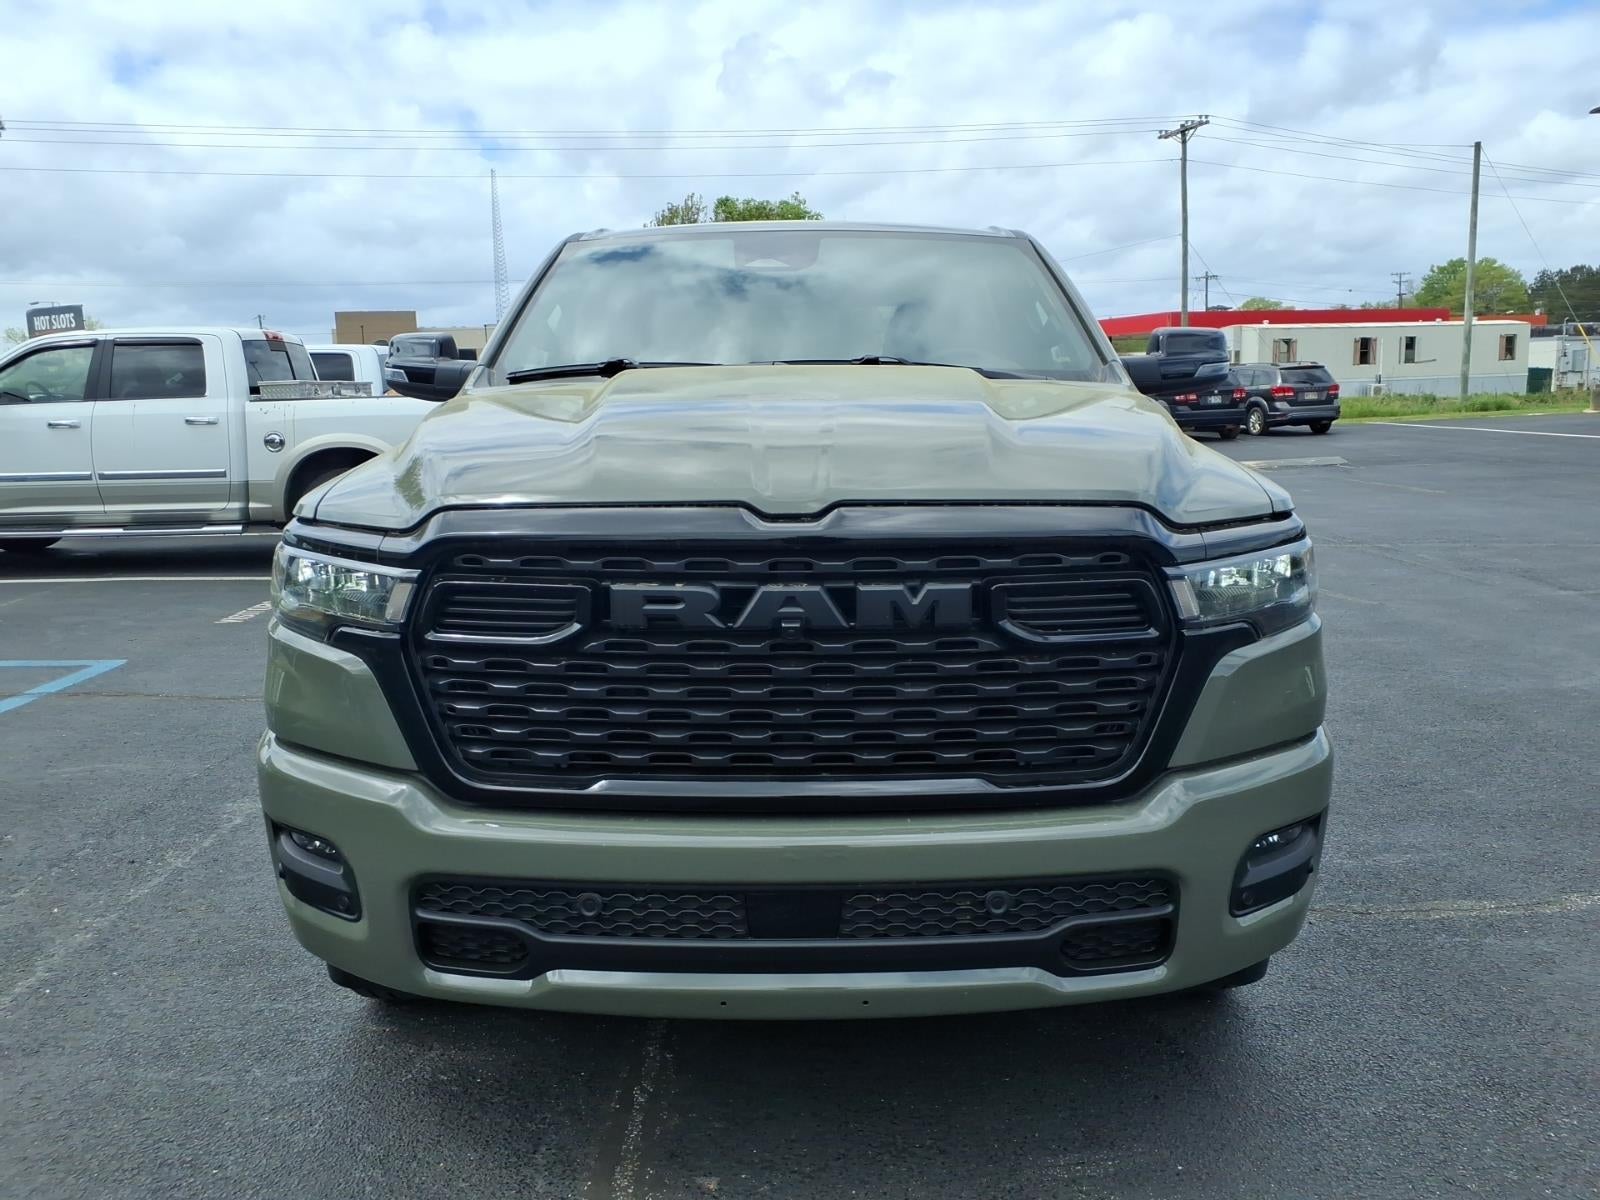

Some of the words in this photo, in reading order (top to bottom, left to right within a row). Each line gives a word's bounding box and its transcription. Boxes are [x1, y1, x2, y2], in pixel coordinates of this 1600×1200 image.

[33, 315, 50, 331] HOT
[51, 312, 76, 330] SLOTS
[610, 582, 972, 629] RAM
